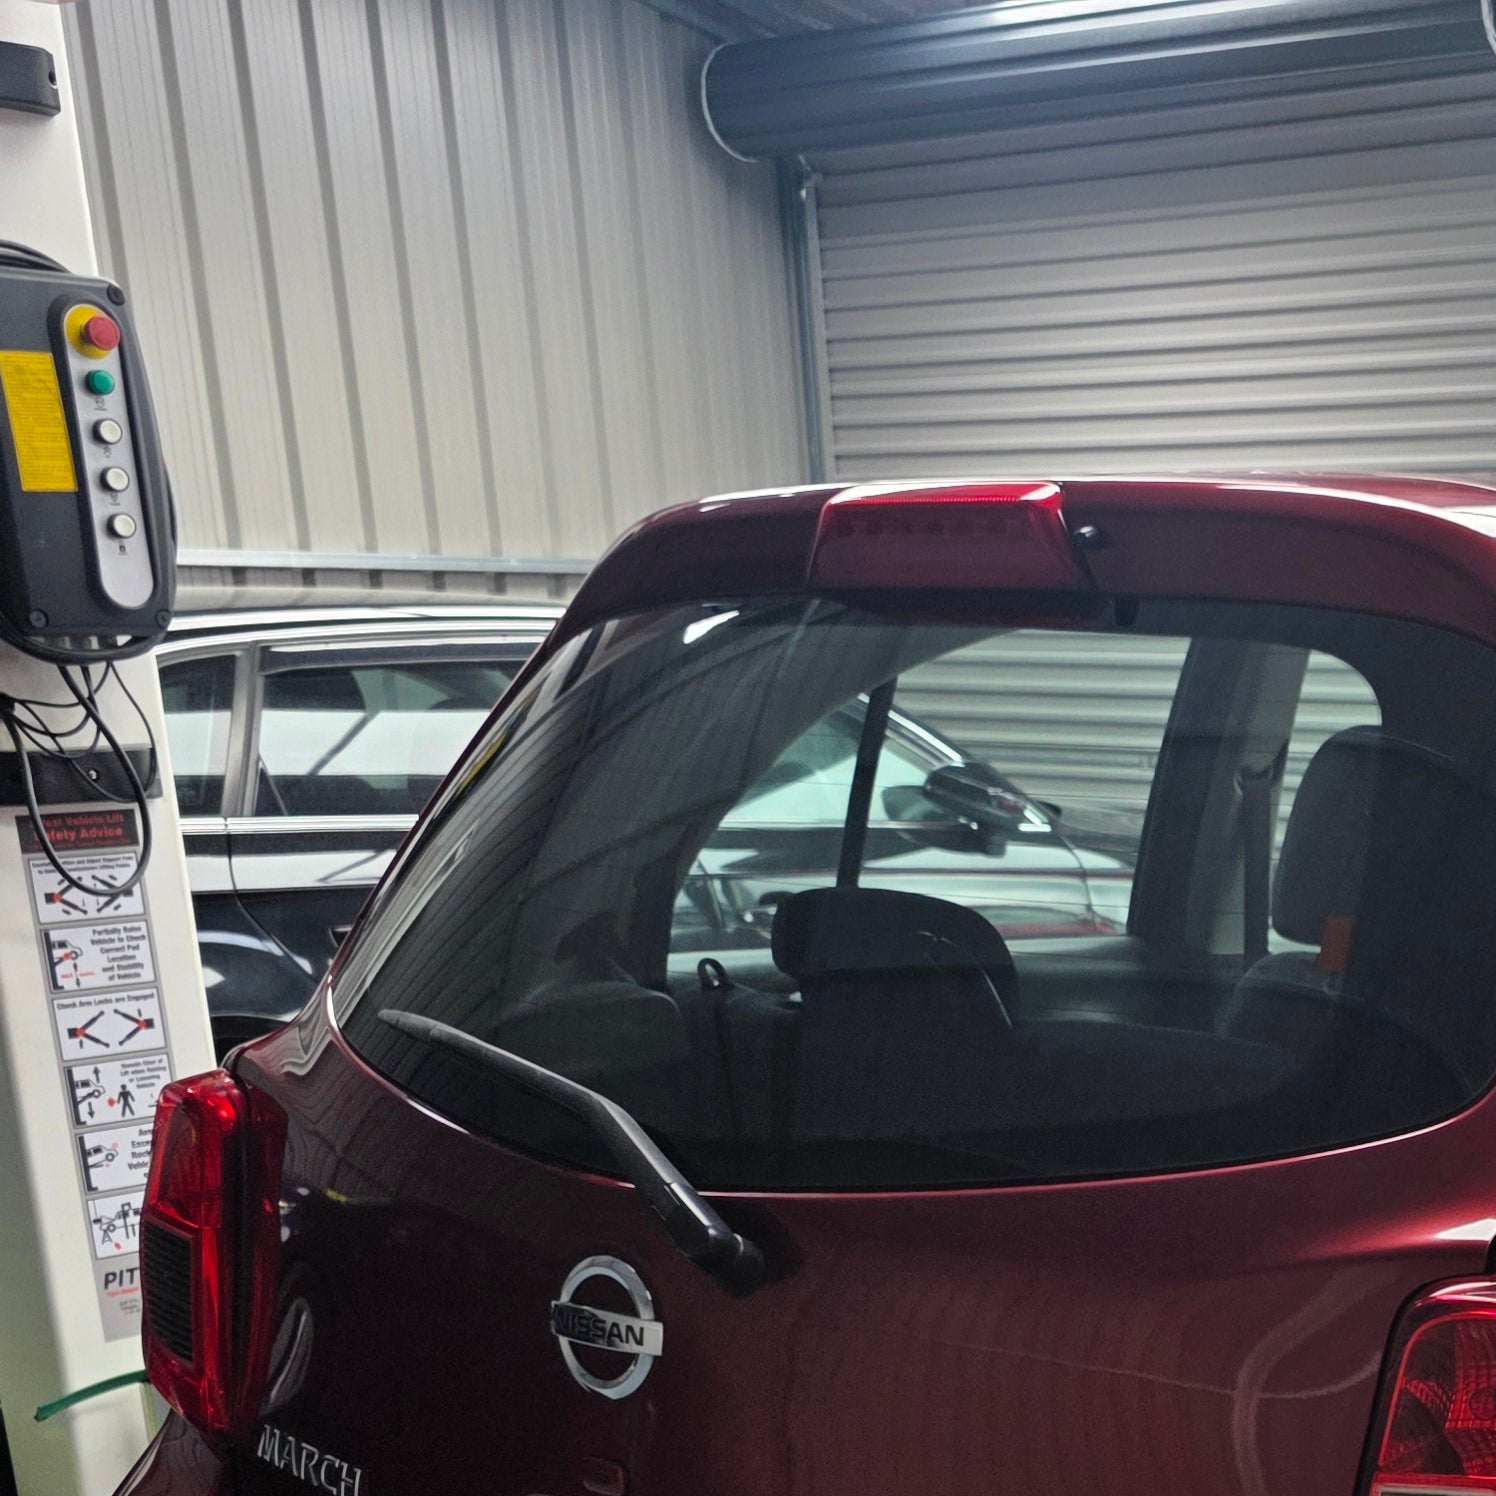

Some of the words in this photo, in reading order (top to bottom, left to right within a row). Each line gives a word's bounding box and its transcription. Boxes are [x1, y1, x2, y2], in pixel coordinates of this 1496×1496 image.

[33, 829, 76, 841] afety
[80, 827, 123, 838] Advice
[554, 1303, 645, 1347] NISSAN
